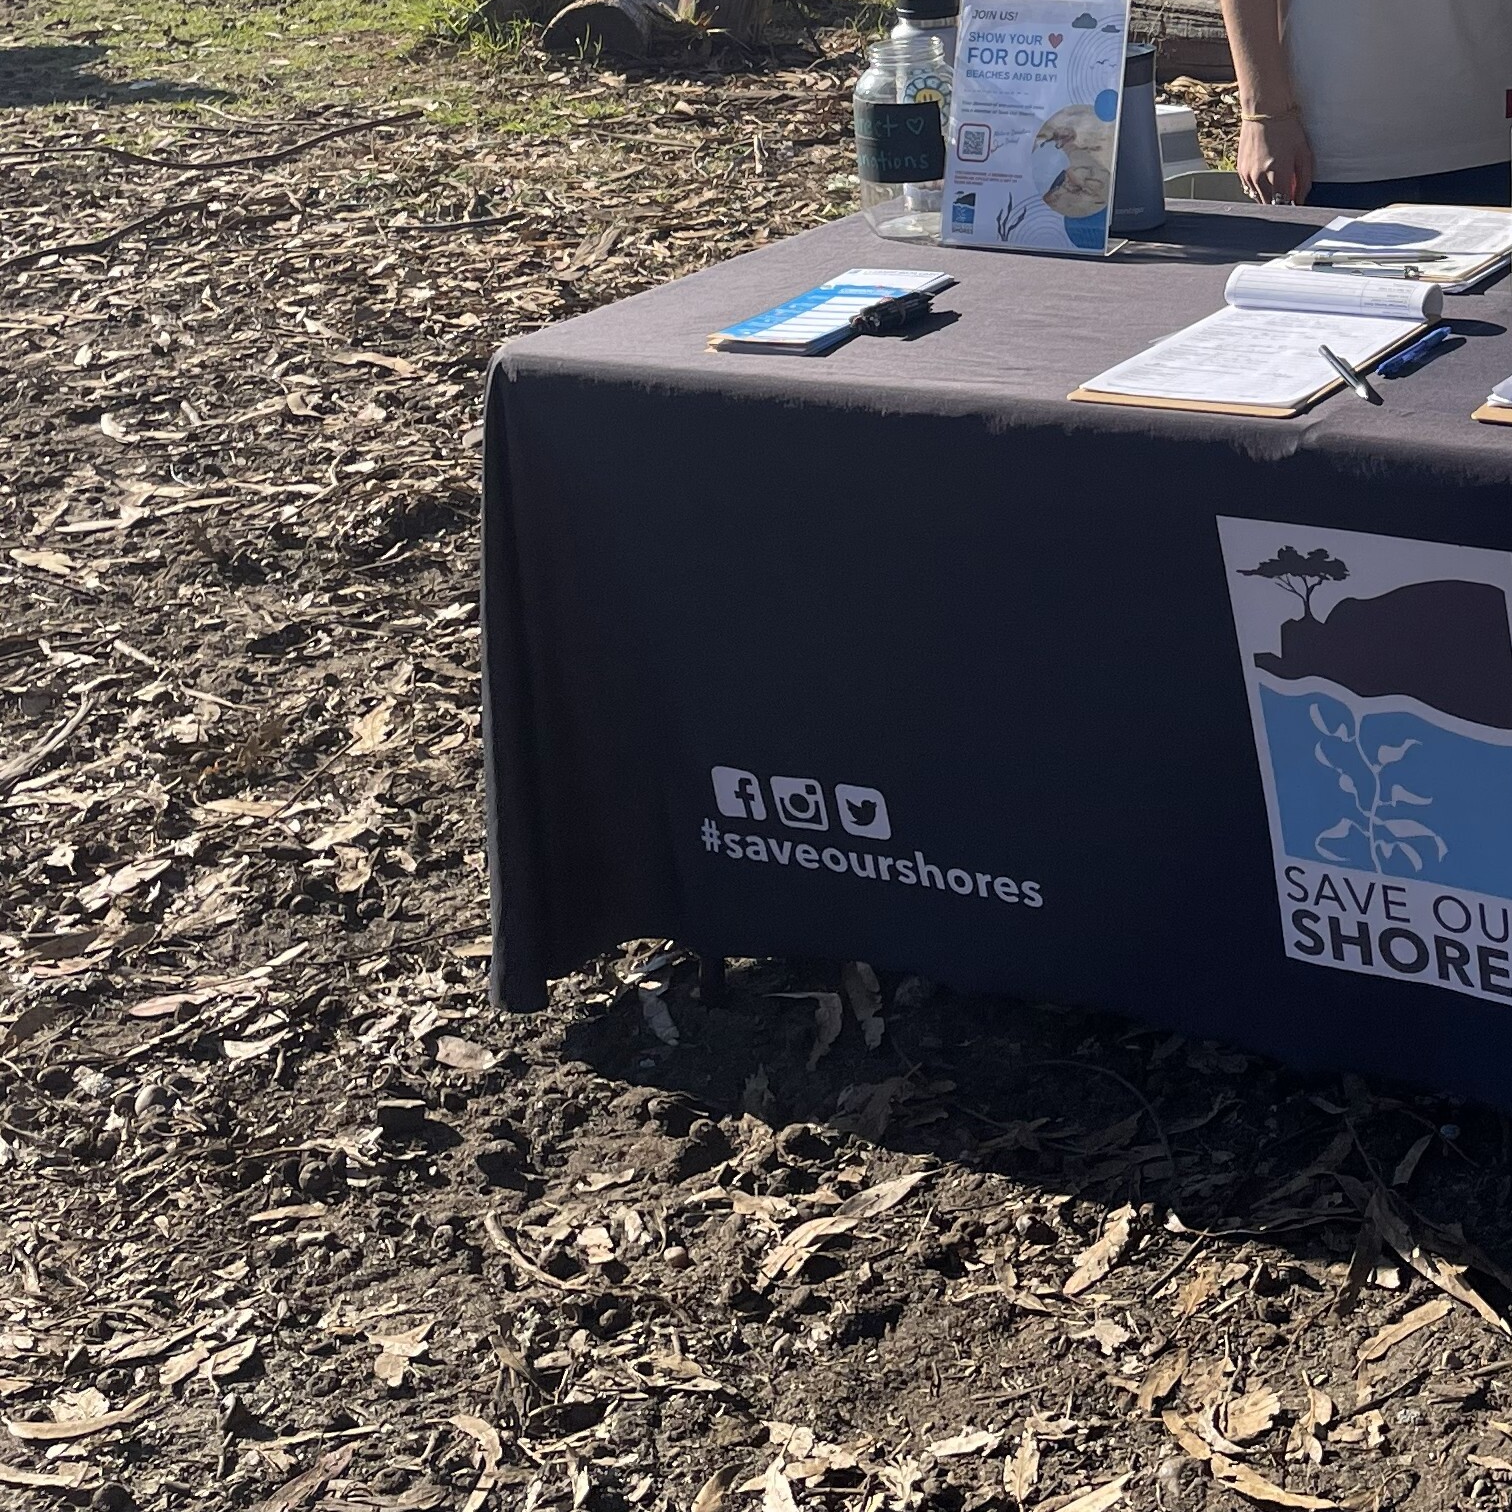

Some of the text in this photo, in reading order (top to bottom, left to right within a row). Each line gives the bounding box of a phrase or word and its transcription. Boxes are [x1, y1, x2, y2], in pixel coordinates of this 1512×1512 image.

[972, 9, 1019, 21] JOIN US!
[968, 31, 1043, 46] SHOW YOUR
[967, 47, 1058, 68] FOR OUR
[966, 69, 1058, 83] BEACHES AND BAY!
[701, 817, 1044, 908] #saveourshores
[1284, 866, 1411, 924] SAVE
